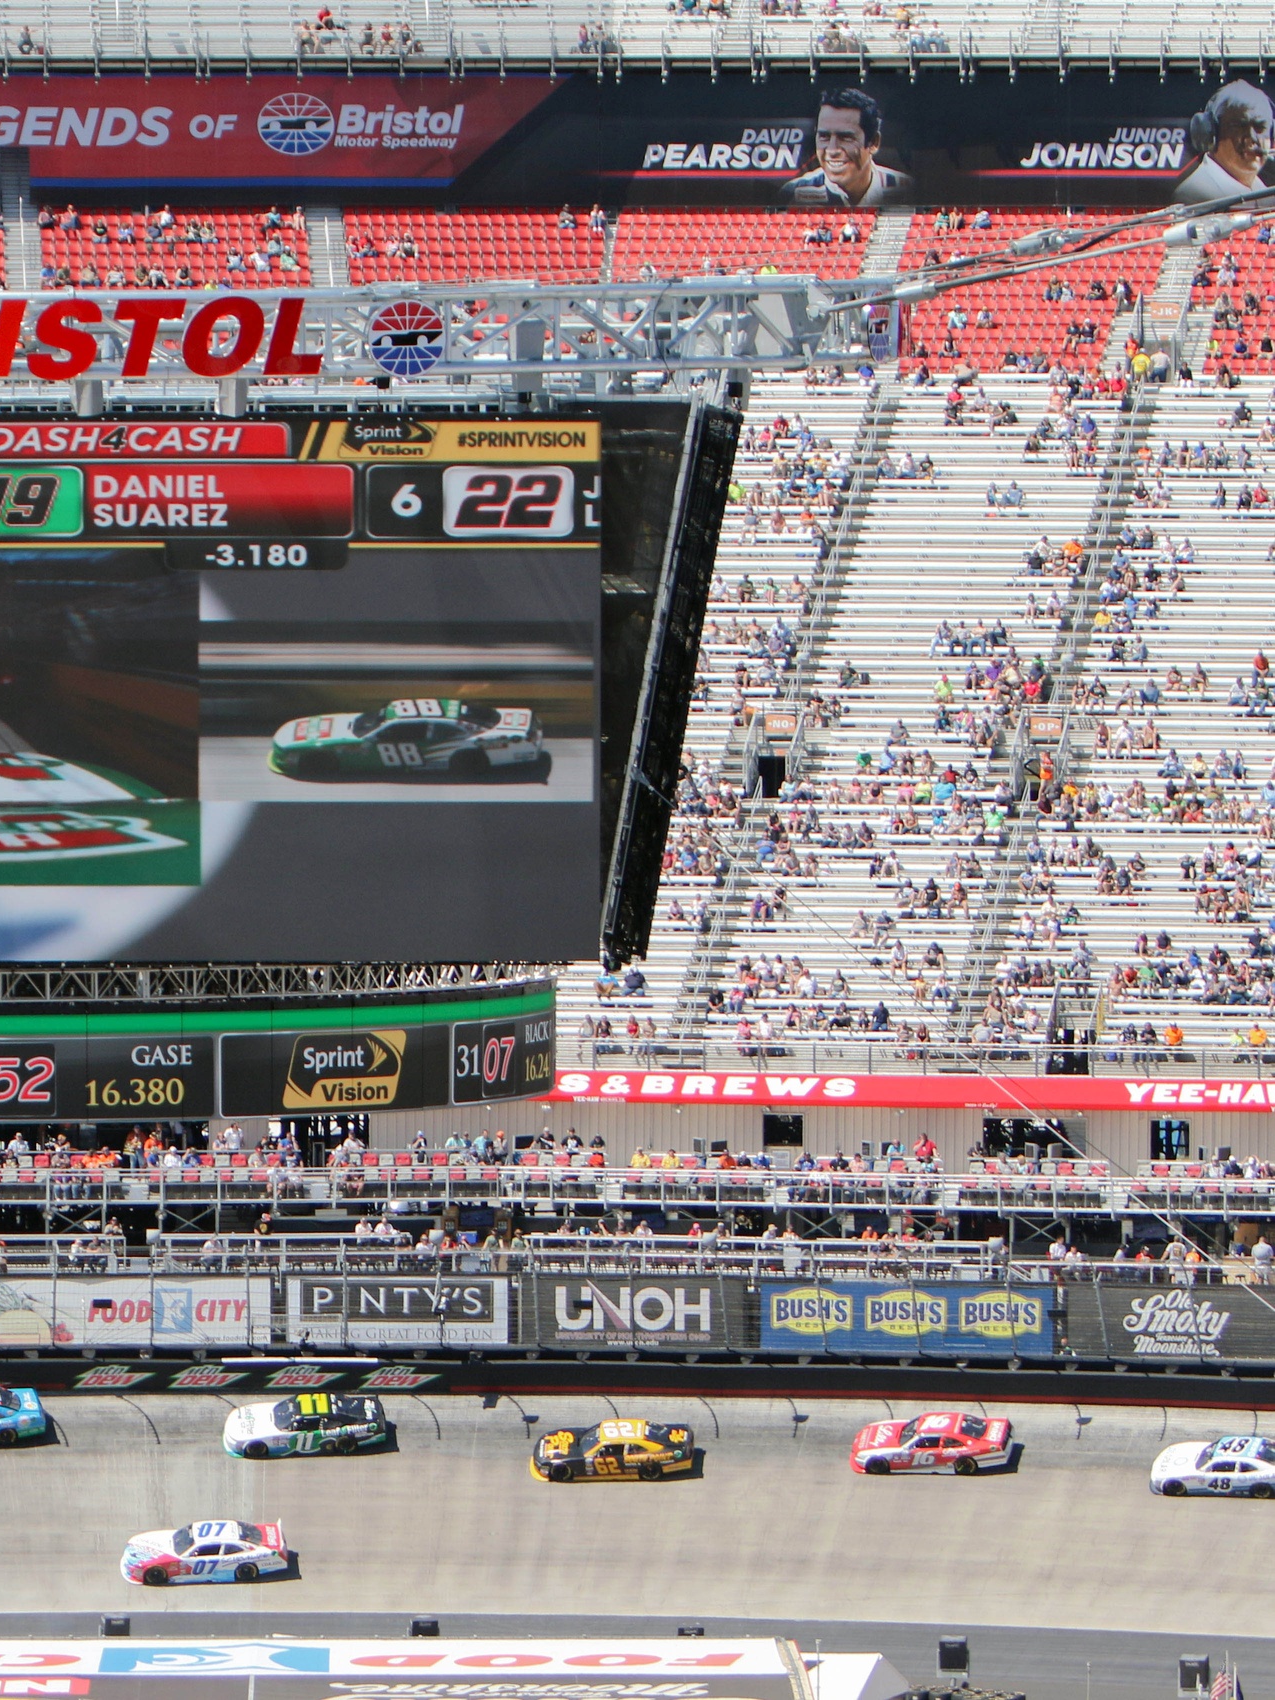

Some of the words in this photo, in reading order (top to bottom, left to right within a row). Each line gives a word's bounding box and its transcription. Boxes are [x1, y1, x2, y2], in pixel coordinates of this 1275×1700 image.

[188, 113, 238, 139] OF
[336, 104, 463, 135] Bristol
[334, 134, 378, 148] Motor
[381, 134, 458, 150] Speedway
[741, 128, 804, 144] DAVID
[1108, 126, 1186, 144] JUNIOR
[642, 143, 802, 170] PEARSON
[1020, 142, 1184, 170] JOHNSON
[354, 425, 402, 442] Sprint
[458, 431, 587, 449] #SPRINTVISION
[367, 444, 424, 457] Vision
[93, 475, 224, 499] DANIEL
[390, 484, 423, 518] 6
[453, 473, 564, 529] 22
[93, 503, 229, 528] SUAREZ
[205, 544, 308, 568] -3.180
[393, 699, 444, 718] 88
[376, 742, 423, 768] 88
[130, 1045, 193, 1066] GASE
[302, 1046, 365, 1074] Sprint
[456, 1043, 481, 1078] 31
[483, 1036, 516, 1084] 07
[525, 1051, 552, 1082] 16.24
[84, 1078, 184, 1107] 16.380
[321, 1081, 389, 1103] Vision
[599, 1075, 631, 1095] &
[640, 1074, 857, 1097] BREWS
[195, 1299, 248, 1322] CITY
[554, 1278, 711, 1331] UNOH
[775, 1298, 848, 1323] BUSH'S
[870, 1299, 943, 1325] BUSH'S
[964, 1302, 1037, 1326] BUSH'S
[1123, 1294, 1231, 1341] Smoky
[366, 1327, 409, 1340] GREAT
[296, 1393, 329, 1415] 11
[295, 1432, 314, 1451] 11
[1217, 1437, 1250, 1453] 48
[593, 1457, 622, 1475] 62
[911, 1451, 935, 1467] 16
[1207, 1477, 1232, 1492] 48
[197, 1522, 228, 1538] 07
[191, 1559, 220, 1576] 07
[349, 1653, 744, 1668] FOOD
